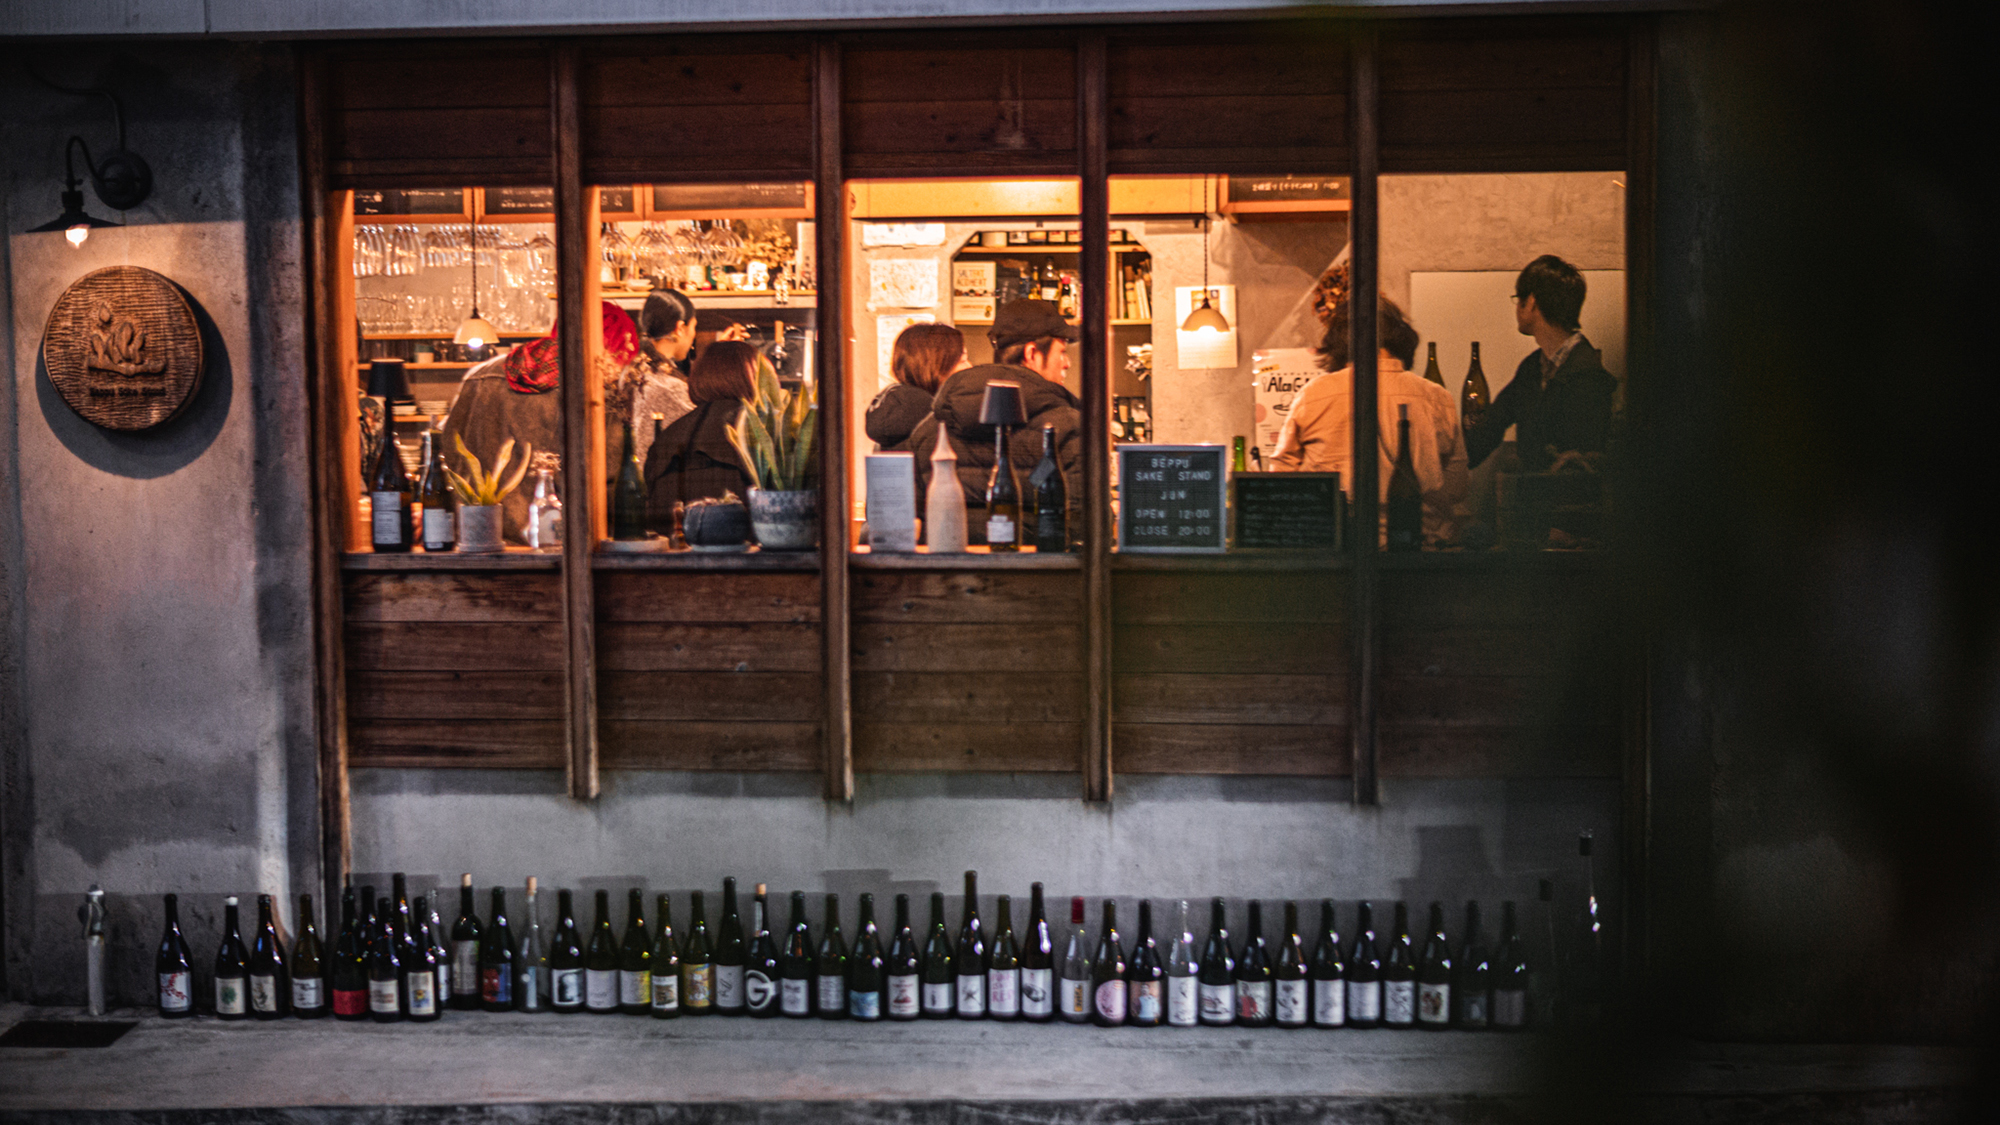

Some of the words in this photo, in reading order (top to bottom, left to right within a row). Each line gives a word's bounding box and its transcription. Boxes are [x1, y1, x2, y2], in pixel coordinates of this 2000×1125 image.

[1151, 458, 1190, 468] BEPPU
[1135, 471, 1164, 481] SAKE
[1178, 470, 1211, 481] STAND
[1135, 509, 1165, 519] OPEN
[1178, 509, 1210, 519] 12:00
[1133, 526, 1169, 536] CLOSE
[1177, 526, 1210, 536] 20:00
